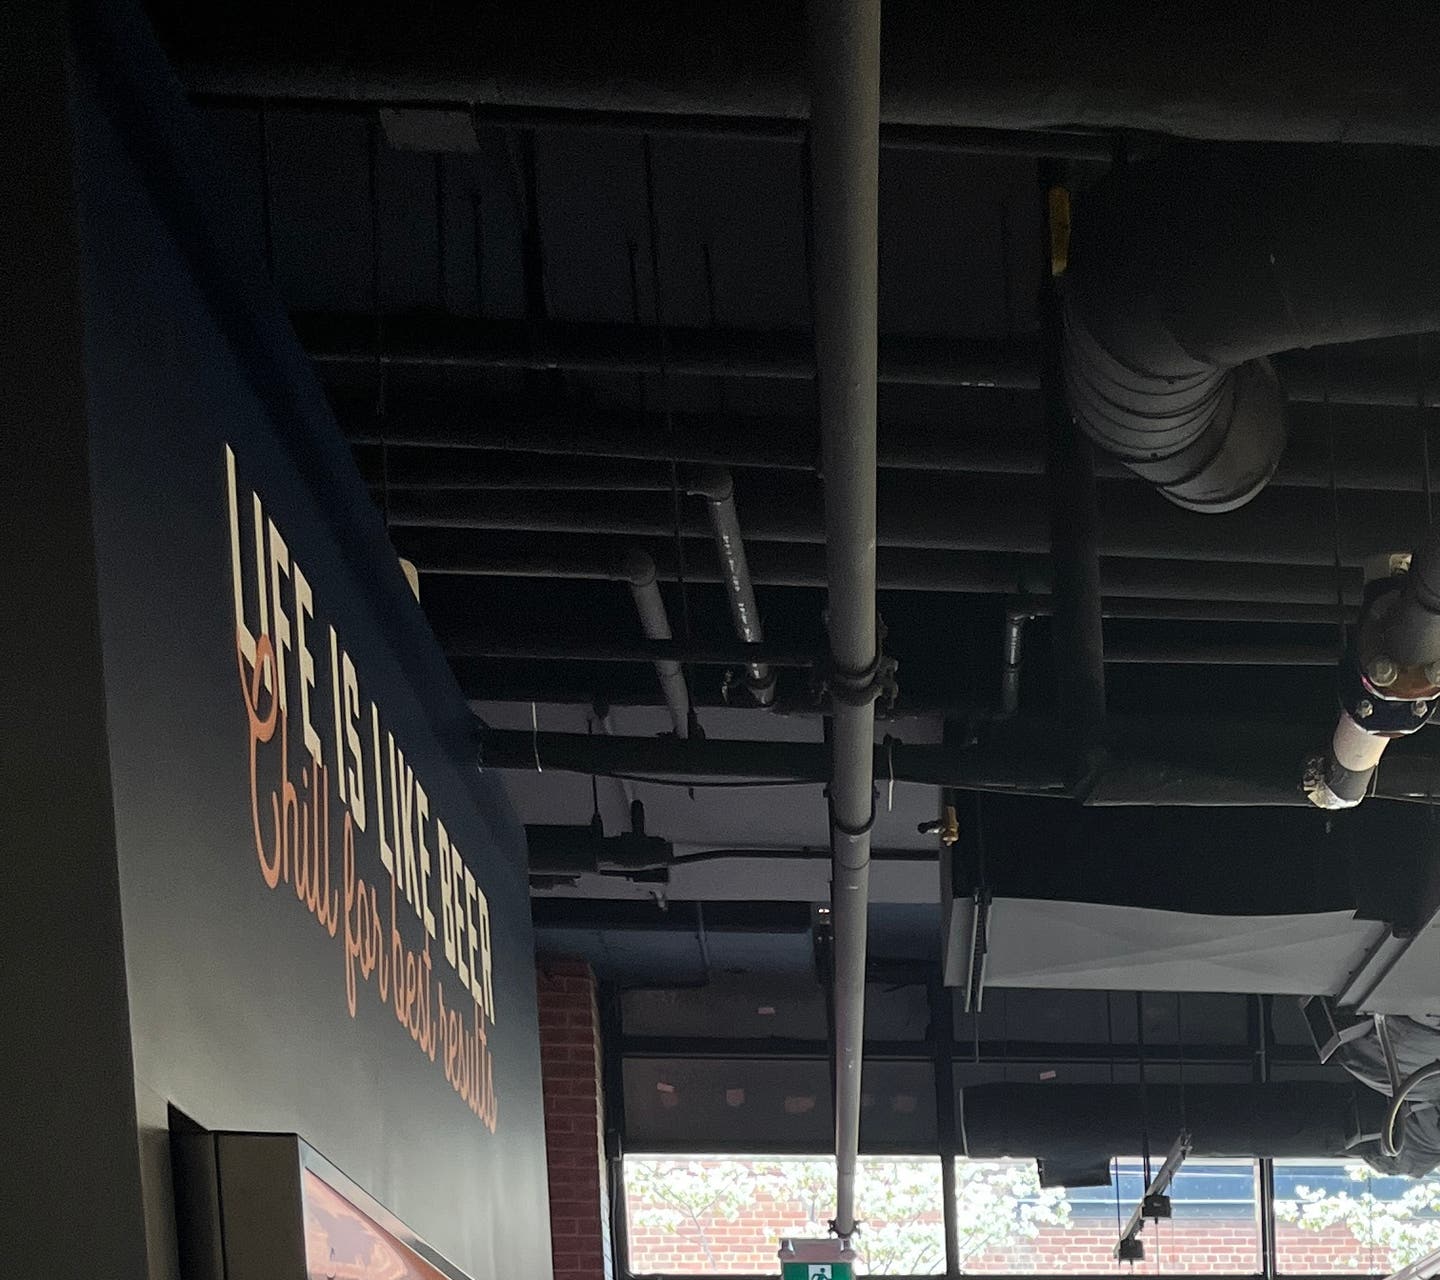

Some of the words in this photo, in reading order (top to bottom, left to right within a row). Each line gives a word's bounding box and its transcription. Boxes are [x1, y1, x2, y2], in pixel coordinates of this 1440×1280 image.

[226, 443, 322, 768] LIFE
[330, 624, 366, 833] IS
[371, 701, 437, 941] LIKE
[437, 817, 496, 1026] BEER
[236, 624, 339, 938] Chill
[343, 810, 389, 1018] for
[390, 872, 437, 1062] best
[438, 982, 498, 1135] results
